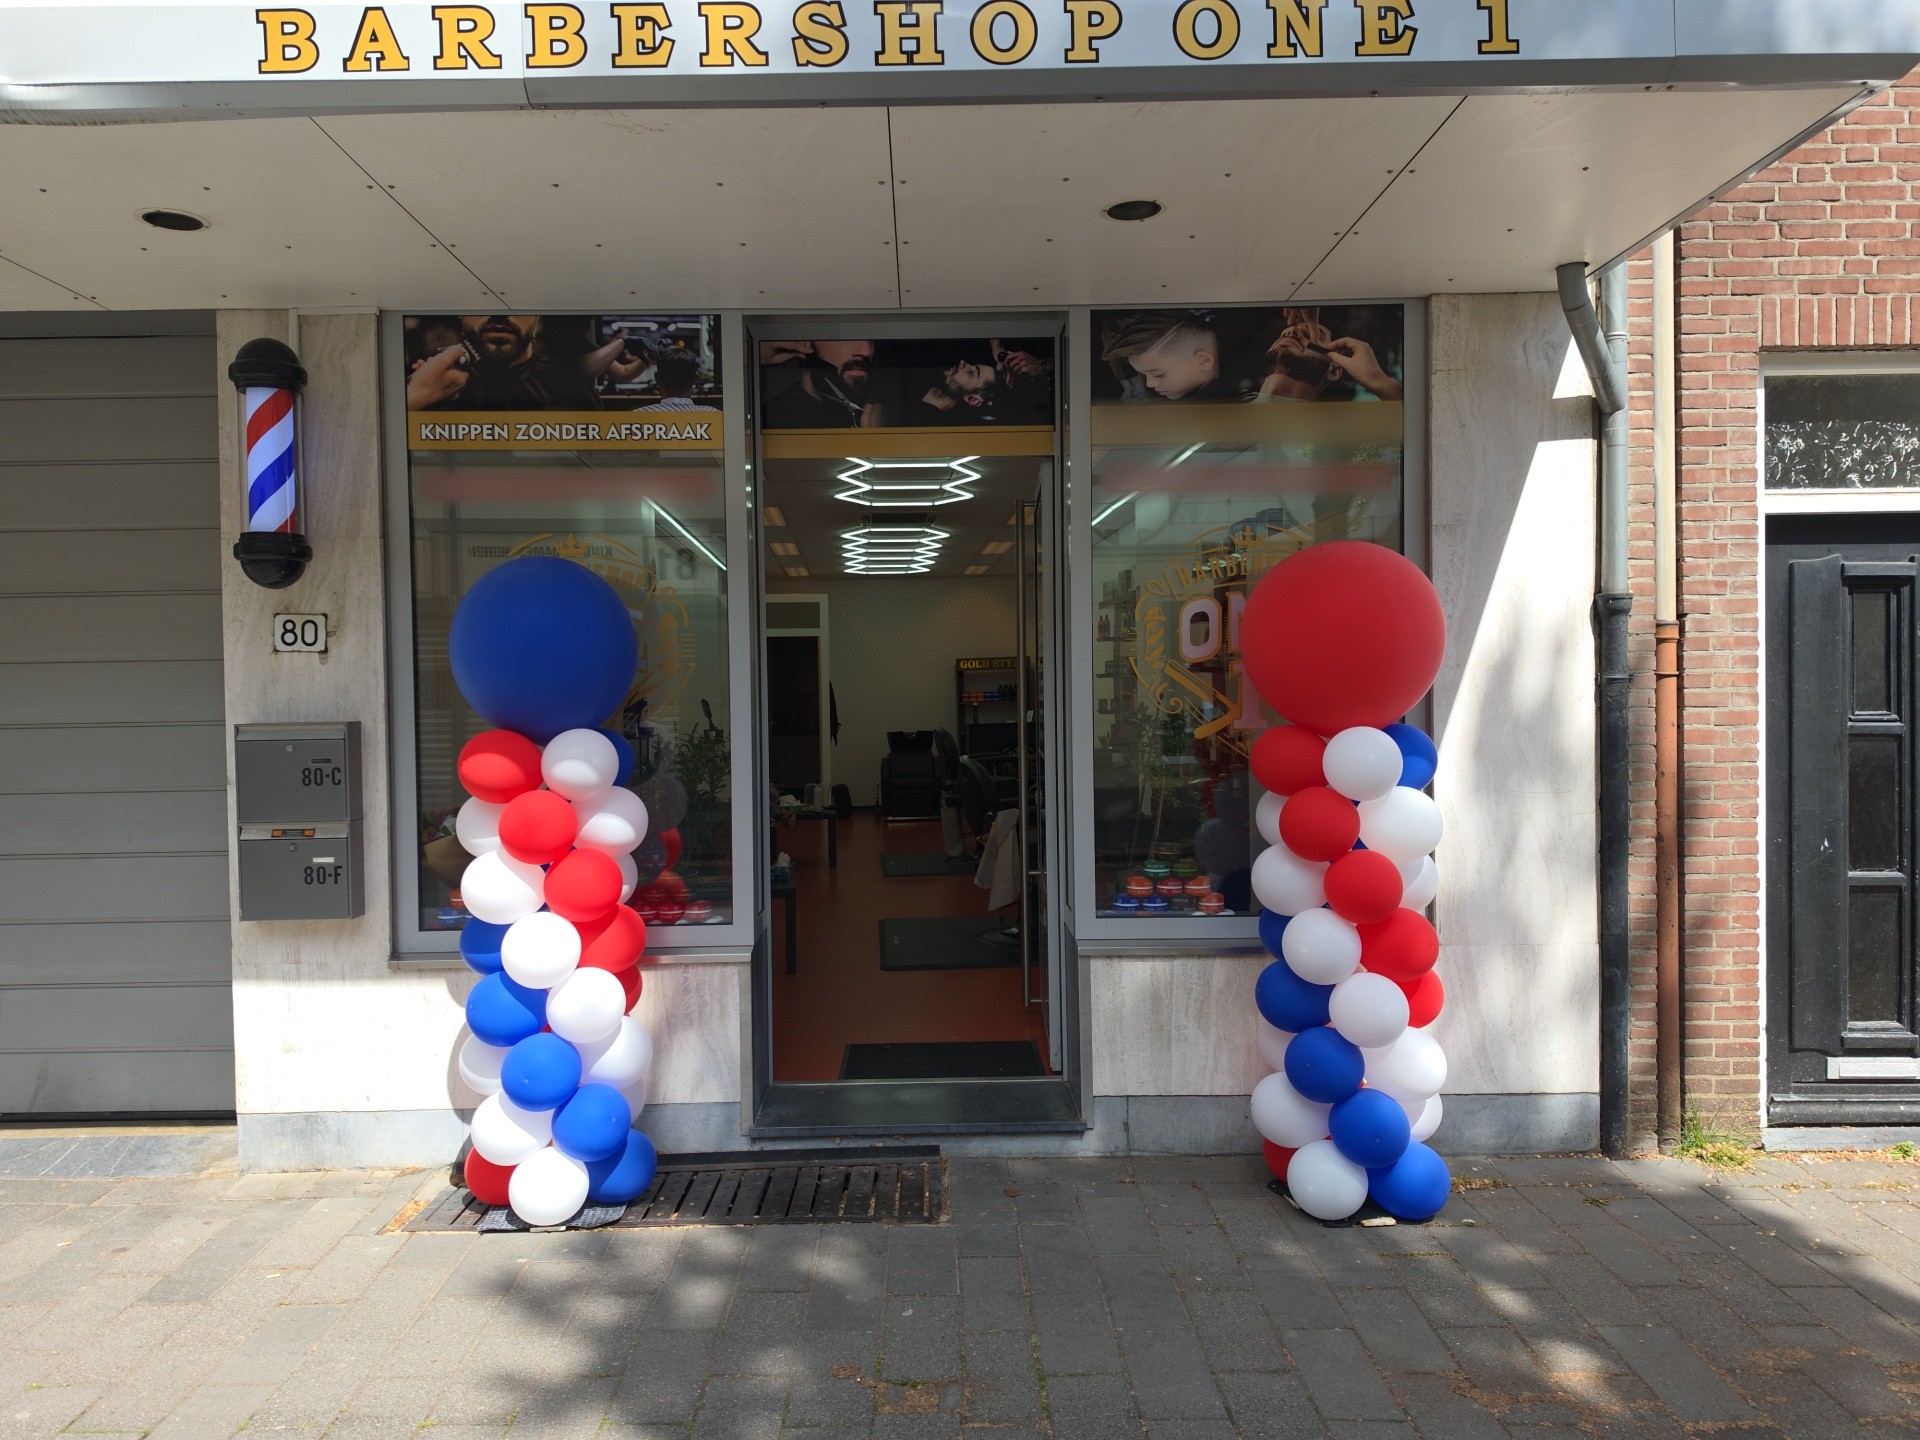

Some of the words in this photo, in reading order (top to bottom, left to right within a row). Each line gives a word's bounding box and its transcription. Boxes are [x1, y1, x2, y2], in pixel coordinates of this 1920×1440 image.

[257, 0, 1123, 74] BARBERSHOP
[1172, 0, 1419, 60] ONE
[1477, 0, 1520, 55] 1
[420, 423, 510, 441] KNIPPEN
[514, 422, 603, 441] ZONDER
[605, 422, 712, 440] AFSPRAAK
[280, 619, 319, 647] 80
[960, 659, 990, 669] GOLD
[302, 767, 342, 786] 80-C
[304, 866, 343, 885] 80-F
